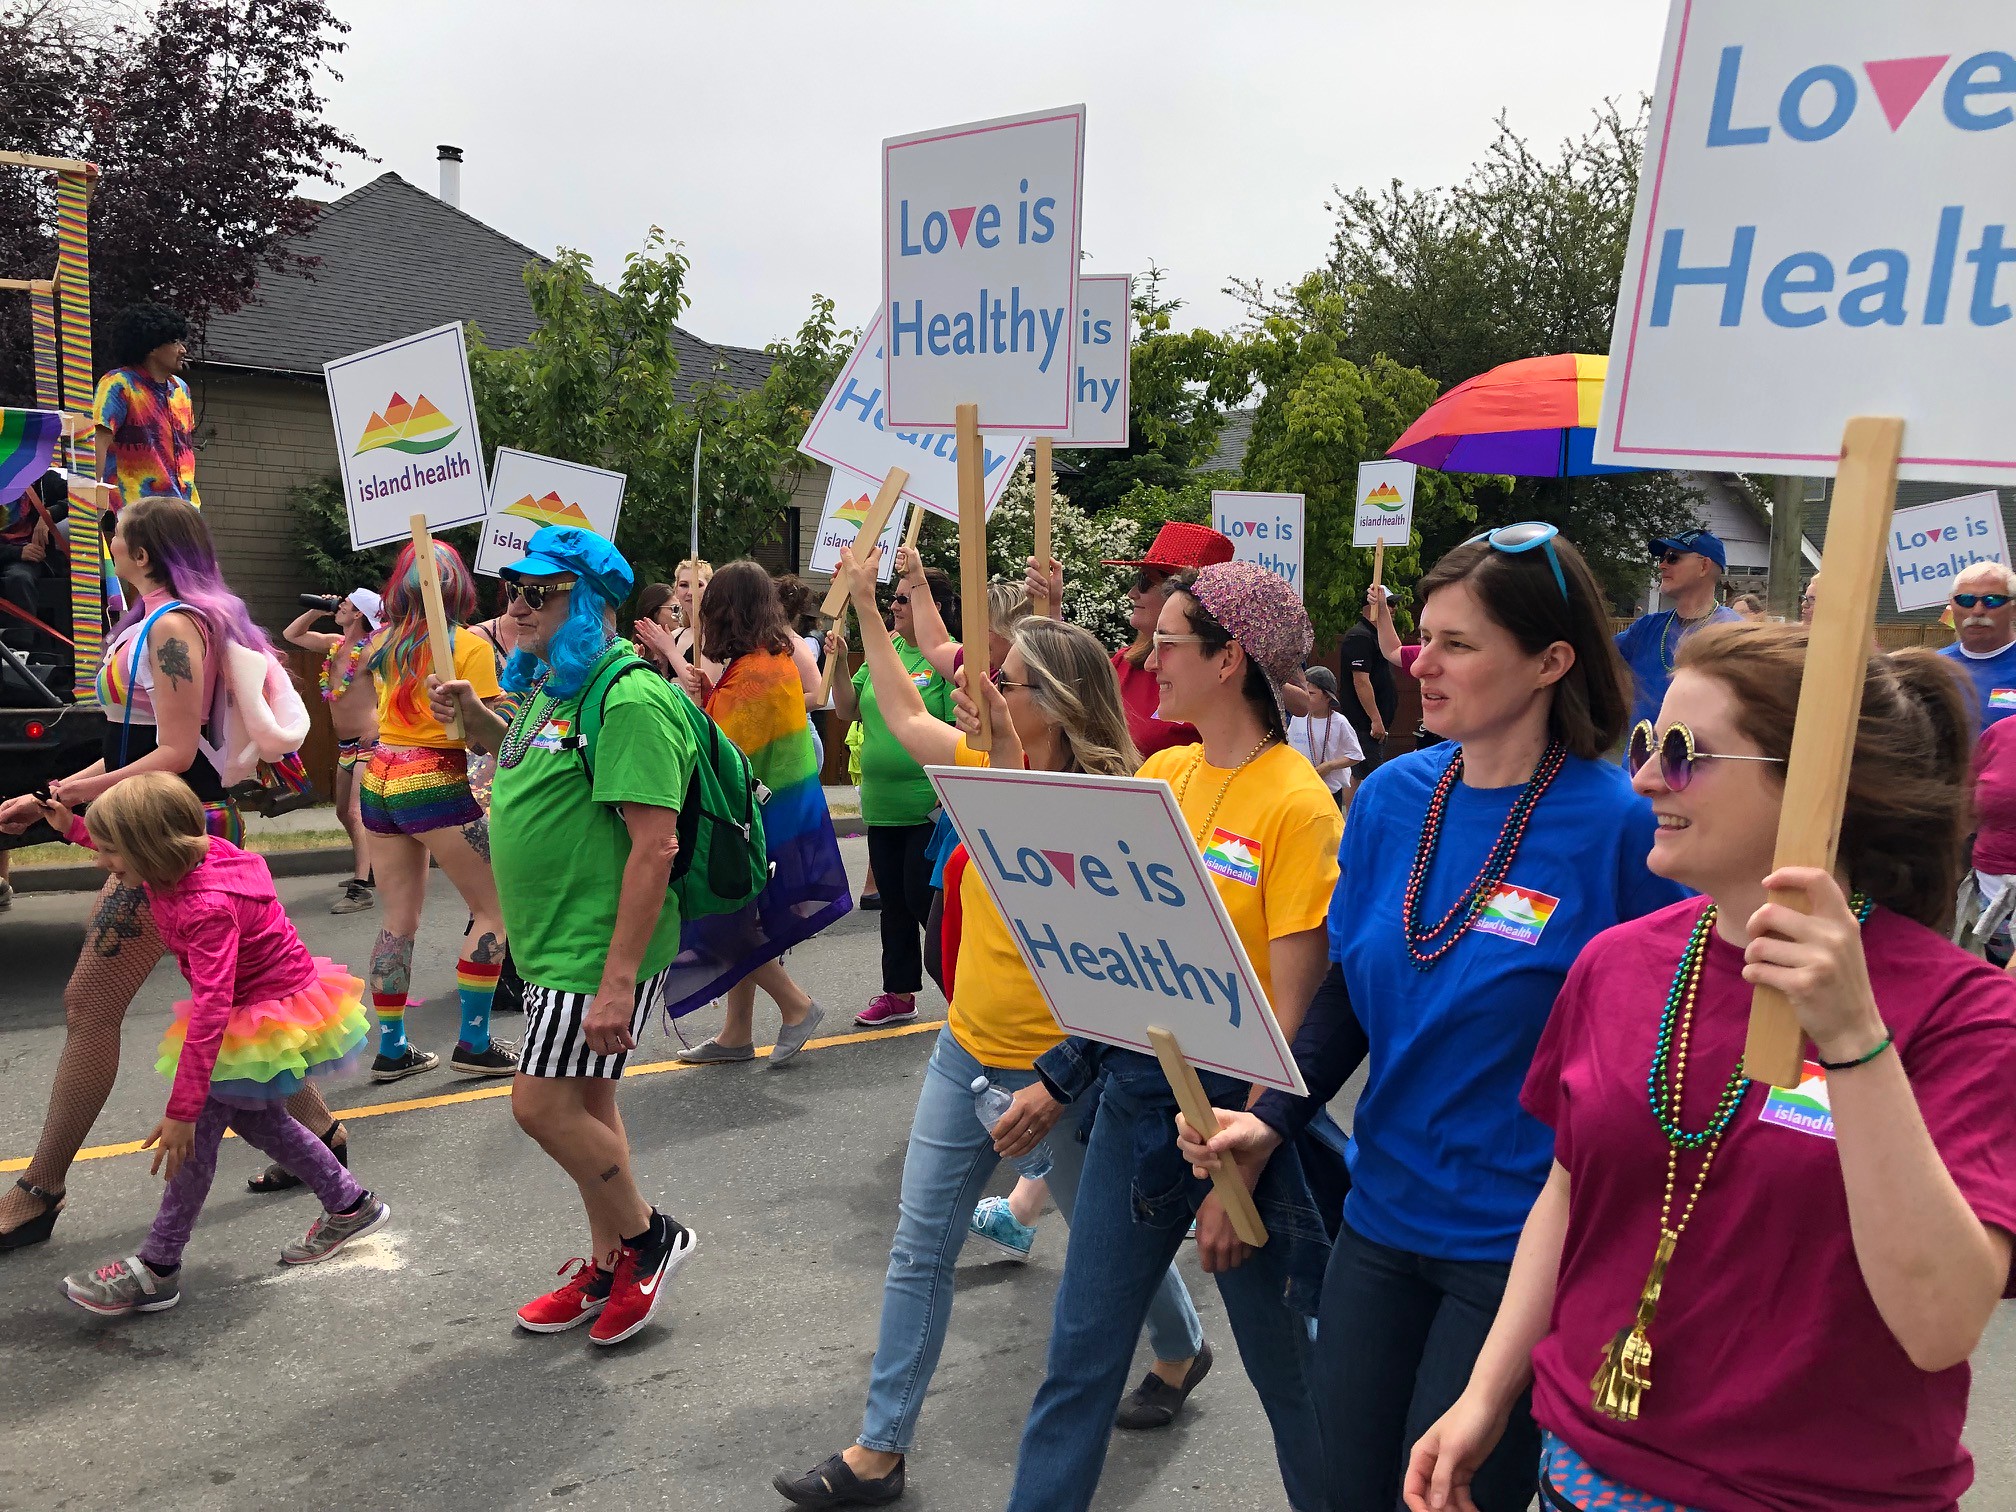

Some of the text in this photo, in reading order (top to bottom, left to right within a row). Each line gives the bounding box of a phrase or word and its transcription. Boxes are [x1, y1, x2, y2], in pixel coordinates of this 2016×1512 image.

[1706, 45, 2016, 148] Love
[901, 178, 1057, 257] Love is
[892, 286, 1066, 374] Healthy
[1082, 308, 1112, 345] is
[358, 451, 471, 503] island health
[1220, 514, 1293, 541] Love is
[1360, 514, 1405, 527] island health
[1895, 516, 1989, 552] Love is
[977, 828, 1186, 908] Love is
[1205, 857, 1253, 882] island health
[1498, 920, 1532, 939] health
[1013, 918, 1242, 1029] Healthy
[1774, 1104, 1824, 1130] island
